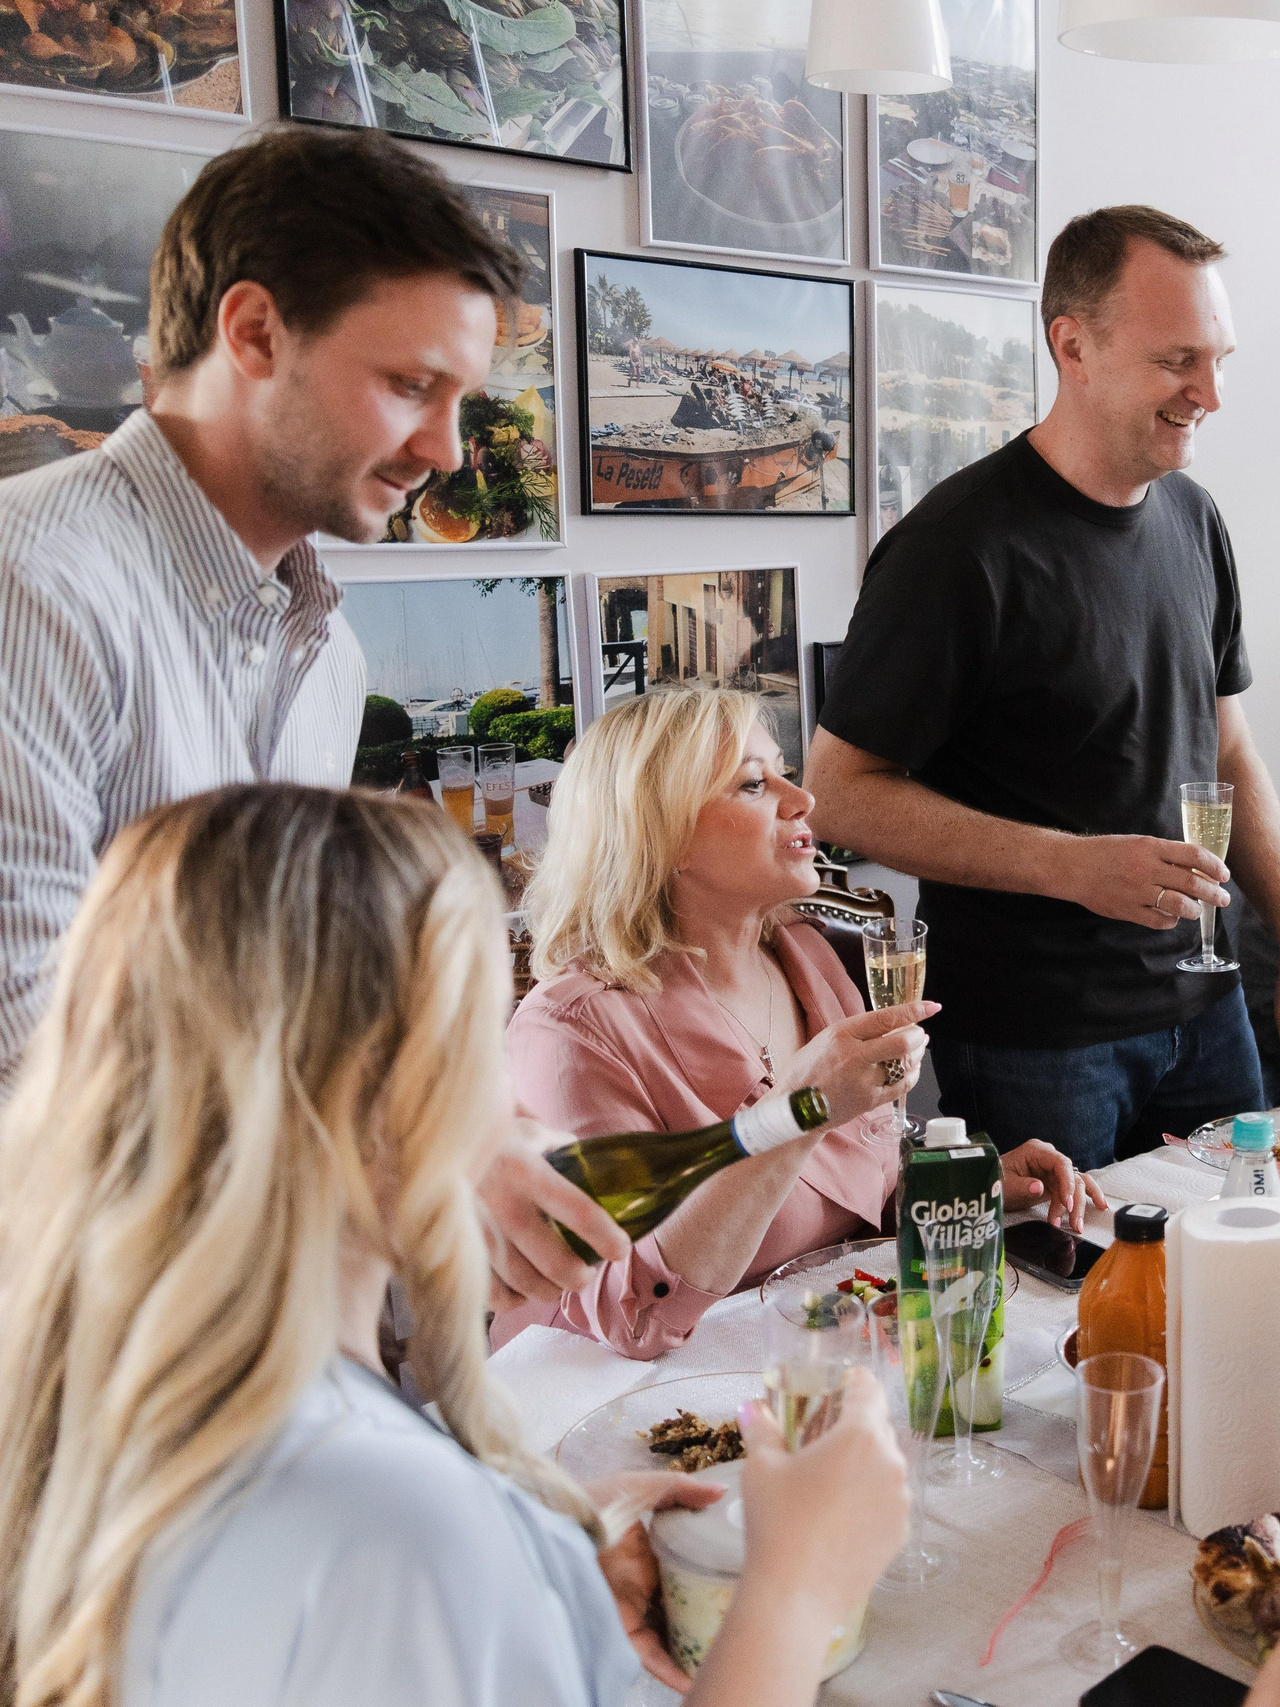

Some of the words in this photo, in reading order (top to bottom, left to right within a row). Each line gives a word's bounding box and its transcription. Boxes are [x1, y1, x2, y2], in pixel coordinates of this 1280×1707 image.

[956, 174, 965, 184] 83
[596, 456, 614, 482] La
[616, 462, 664, 490] Peseta
[486, 782, 511, 792] EFES
[911, 1193, 986, 1225] Global
[917, 1221, 999, 1249] Village
